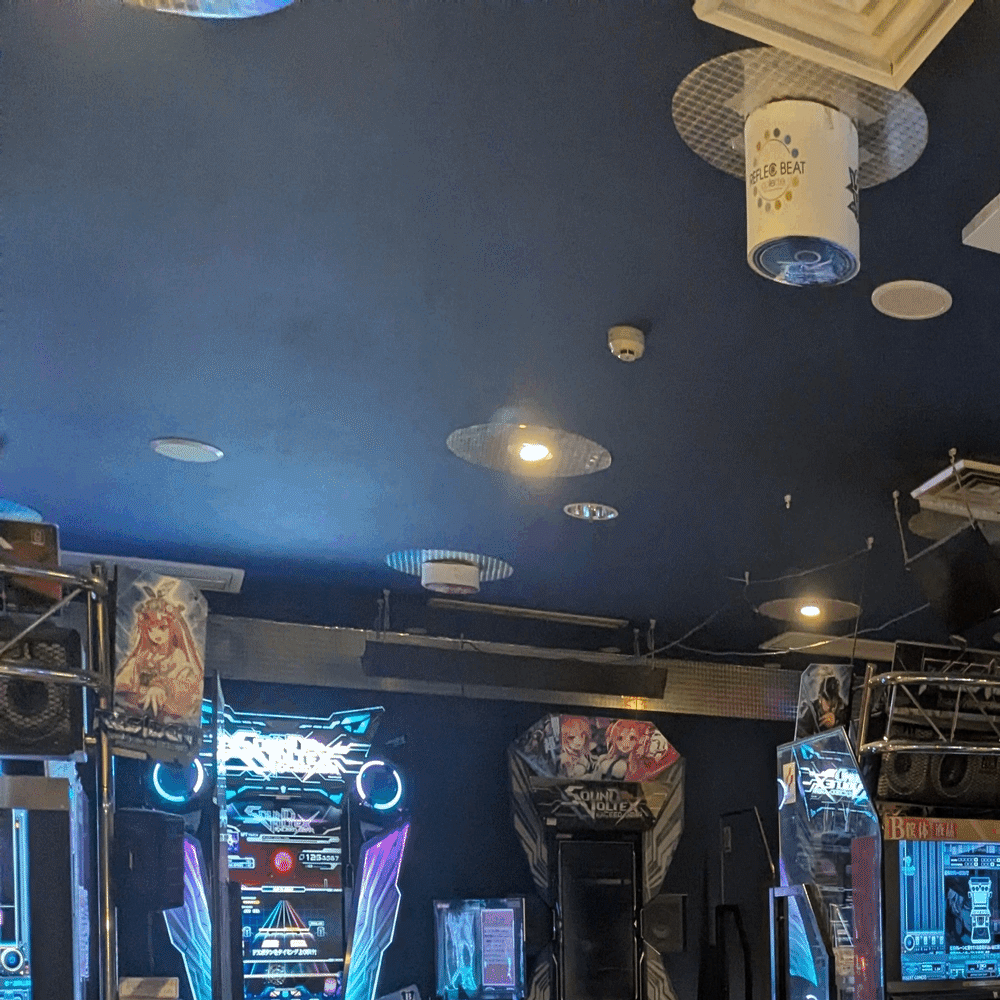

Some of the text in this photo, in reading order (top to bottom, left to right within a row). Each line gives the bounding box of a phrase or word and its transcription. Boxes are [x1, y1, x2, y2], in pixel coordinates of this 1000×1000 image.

[780, 161, 806, 175] BEAT
[565, 785, 619, 802] SOUND
[570, 797, 642, 826] VOLTEX
